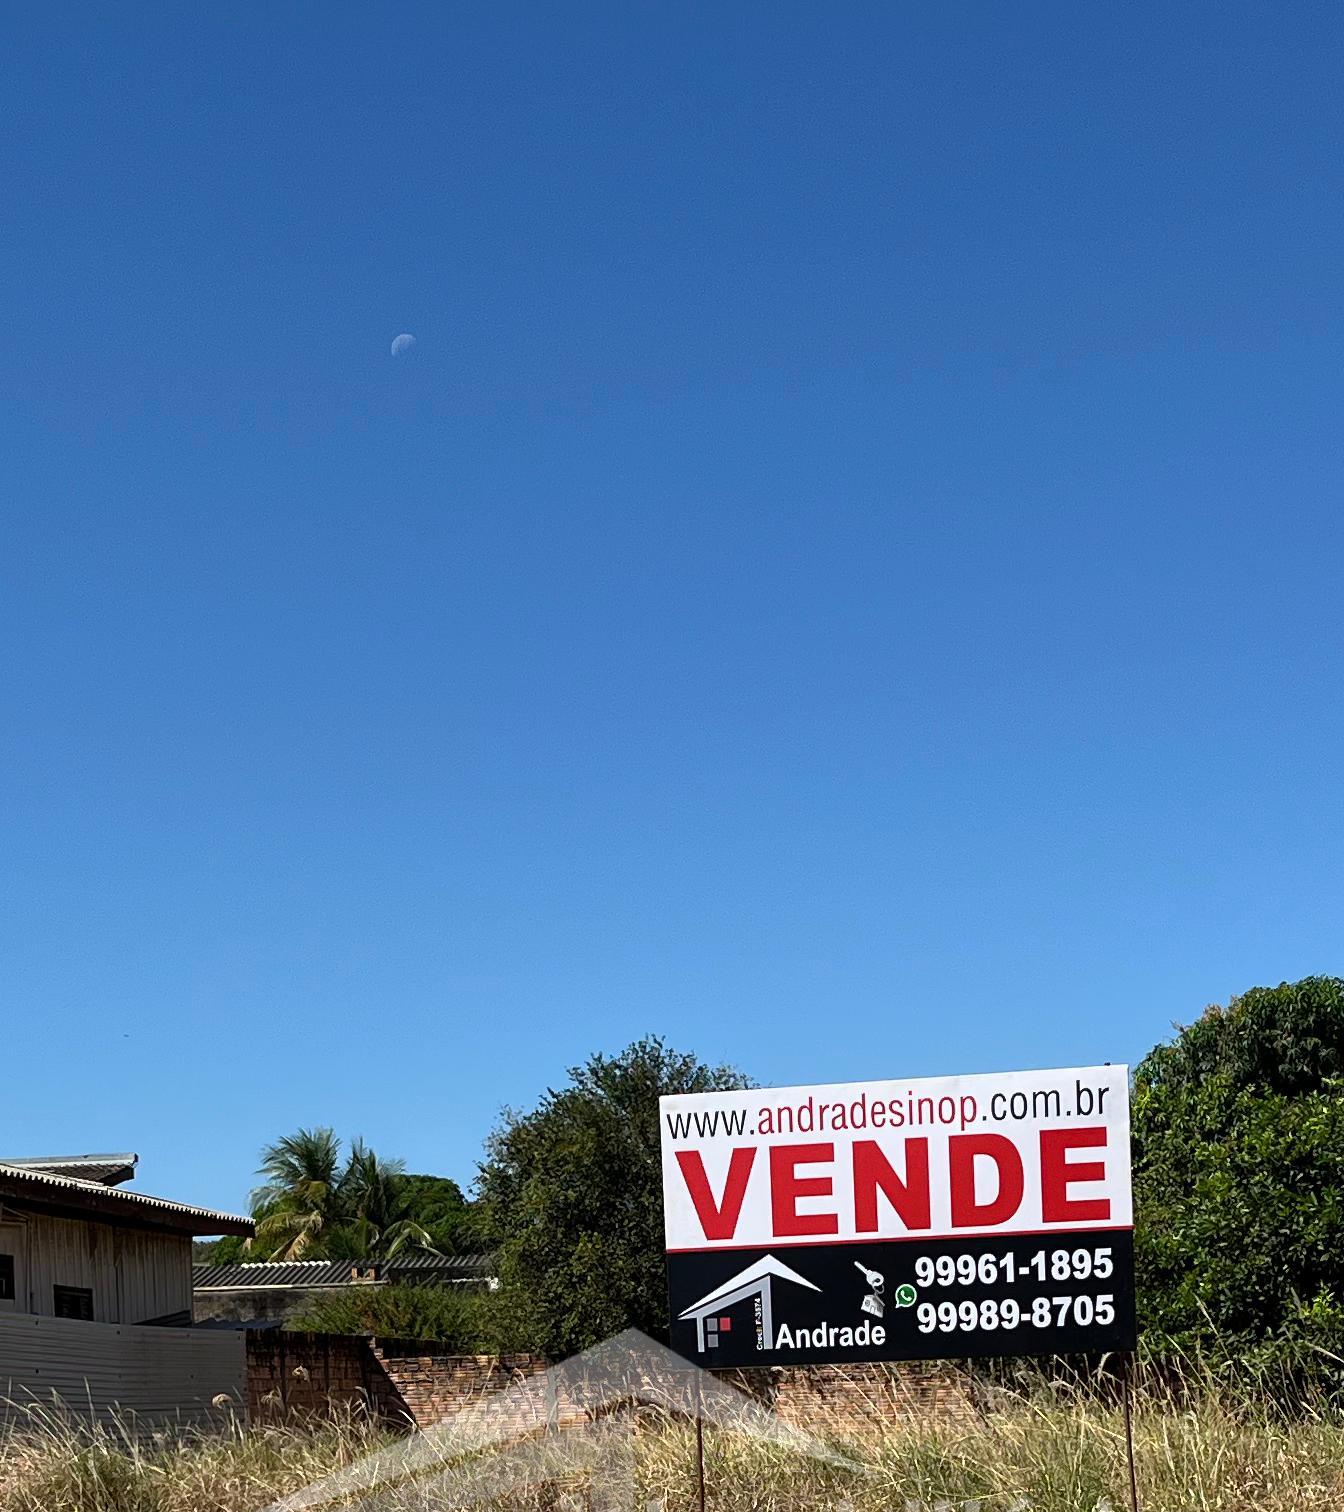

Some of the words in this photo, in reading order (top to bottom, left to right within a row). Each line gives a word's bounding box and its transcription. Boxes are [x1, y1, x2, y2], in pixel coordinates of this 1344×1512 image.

[666, 1080, 1110, 1140] www.andradesinop.com.br
[674, 1126, 1112, 1241] VENDE
[915, 1247, 1114, 1288] 99961-1895
[774, 1319, 886, 1350] Andrade
[916, 1294, 1115, 1334] 99989-8705
